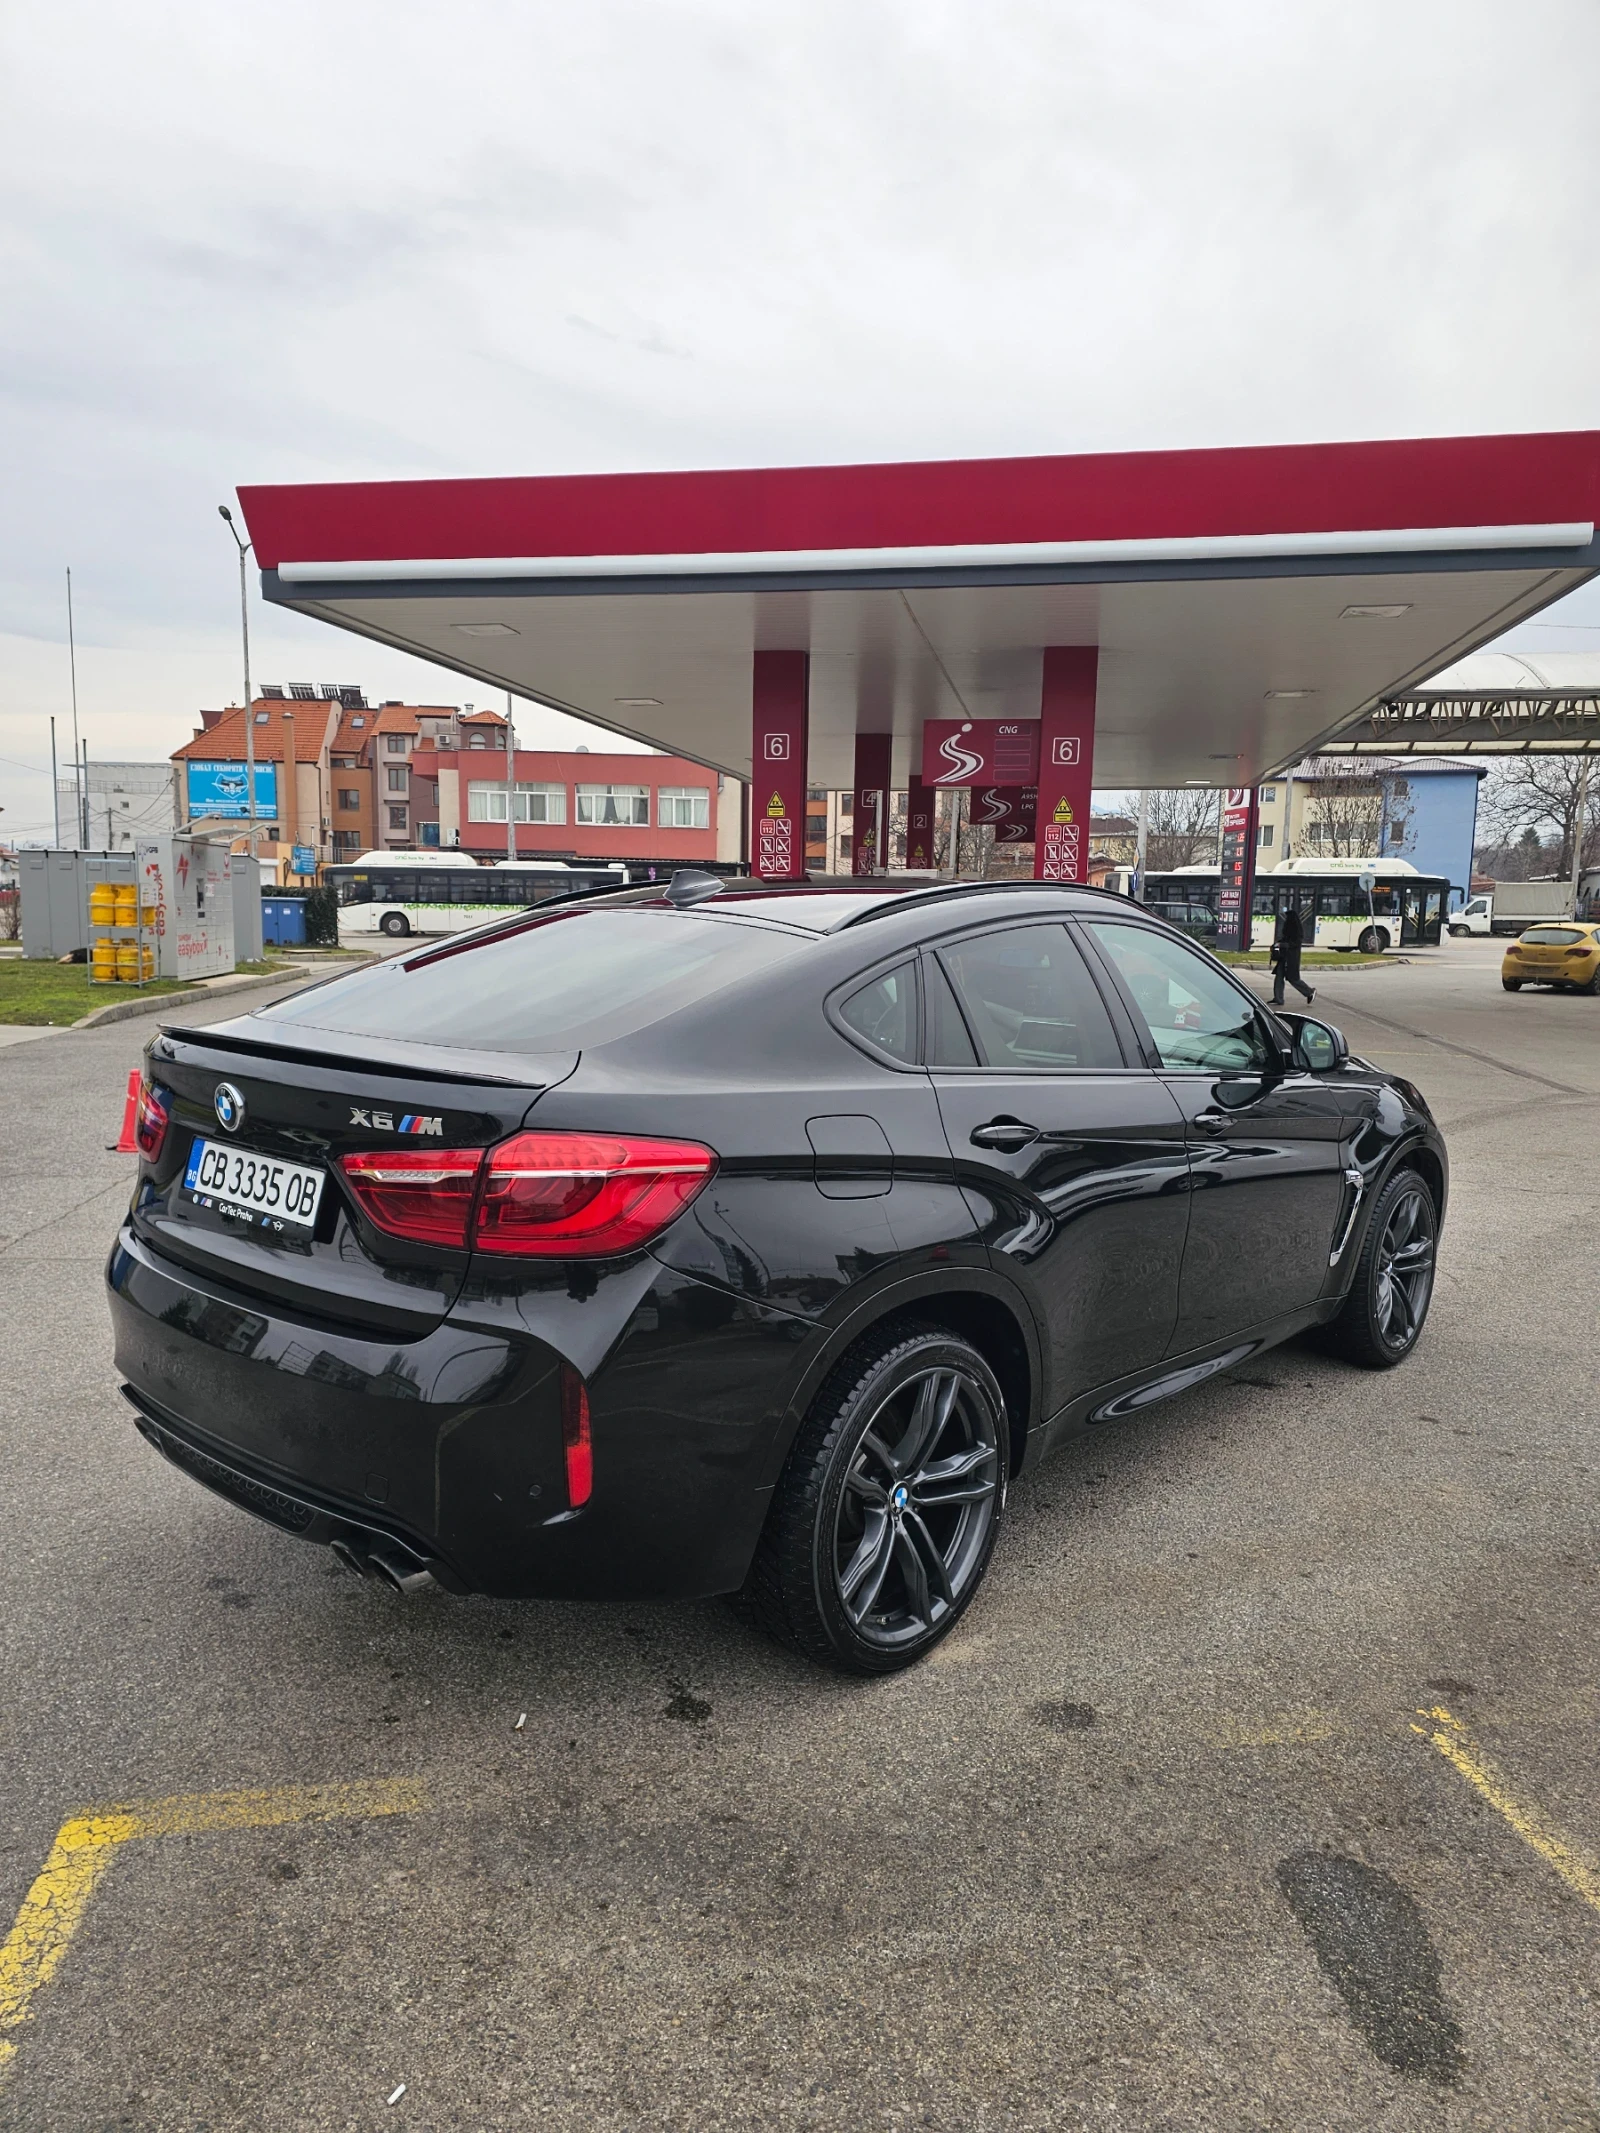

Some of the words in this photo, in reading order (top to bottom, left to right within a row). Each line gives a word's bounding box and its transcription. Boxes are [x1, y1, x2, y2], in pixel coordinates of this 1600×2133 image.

[998, 725, 1018, 734] CNG
[770, 737, 783, 756] 6
[1059, 740, 1073, 761] 6
[245, 765, 273, 774] СРВИСИС
[866, 792, 877, 805] 4
[916, 816, 924, 827] 2
[762, 826, 773, 834] 112
[177, 938, 204, 960] easybox
[349, 1107, 395, 1131] X6
[186, 1169, 198, 1182] BG
[200, 1149, 229, 1190] CB
[228, 1157, 284, 1207] 3335
